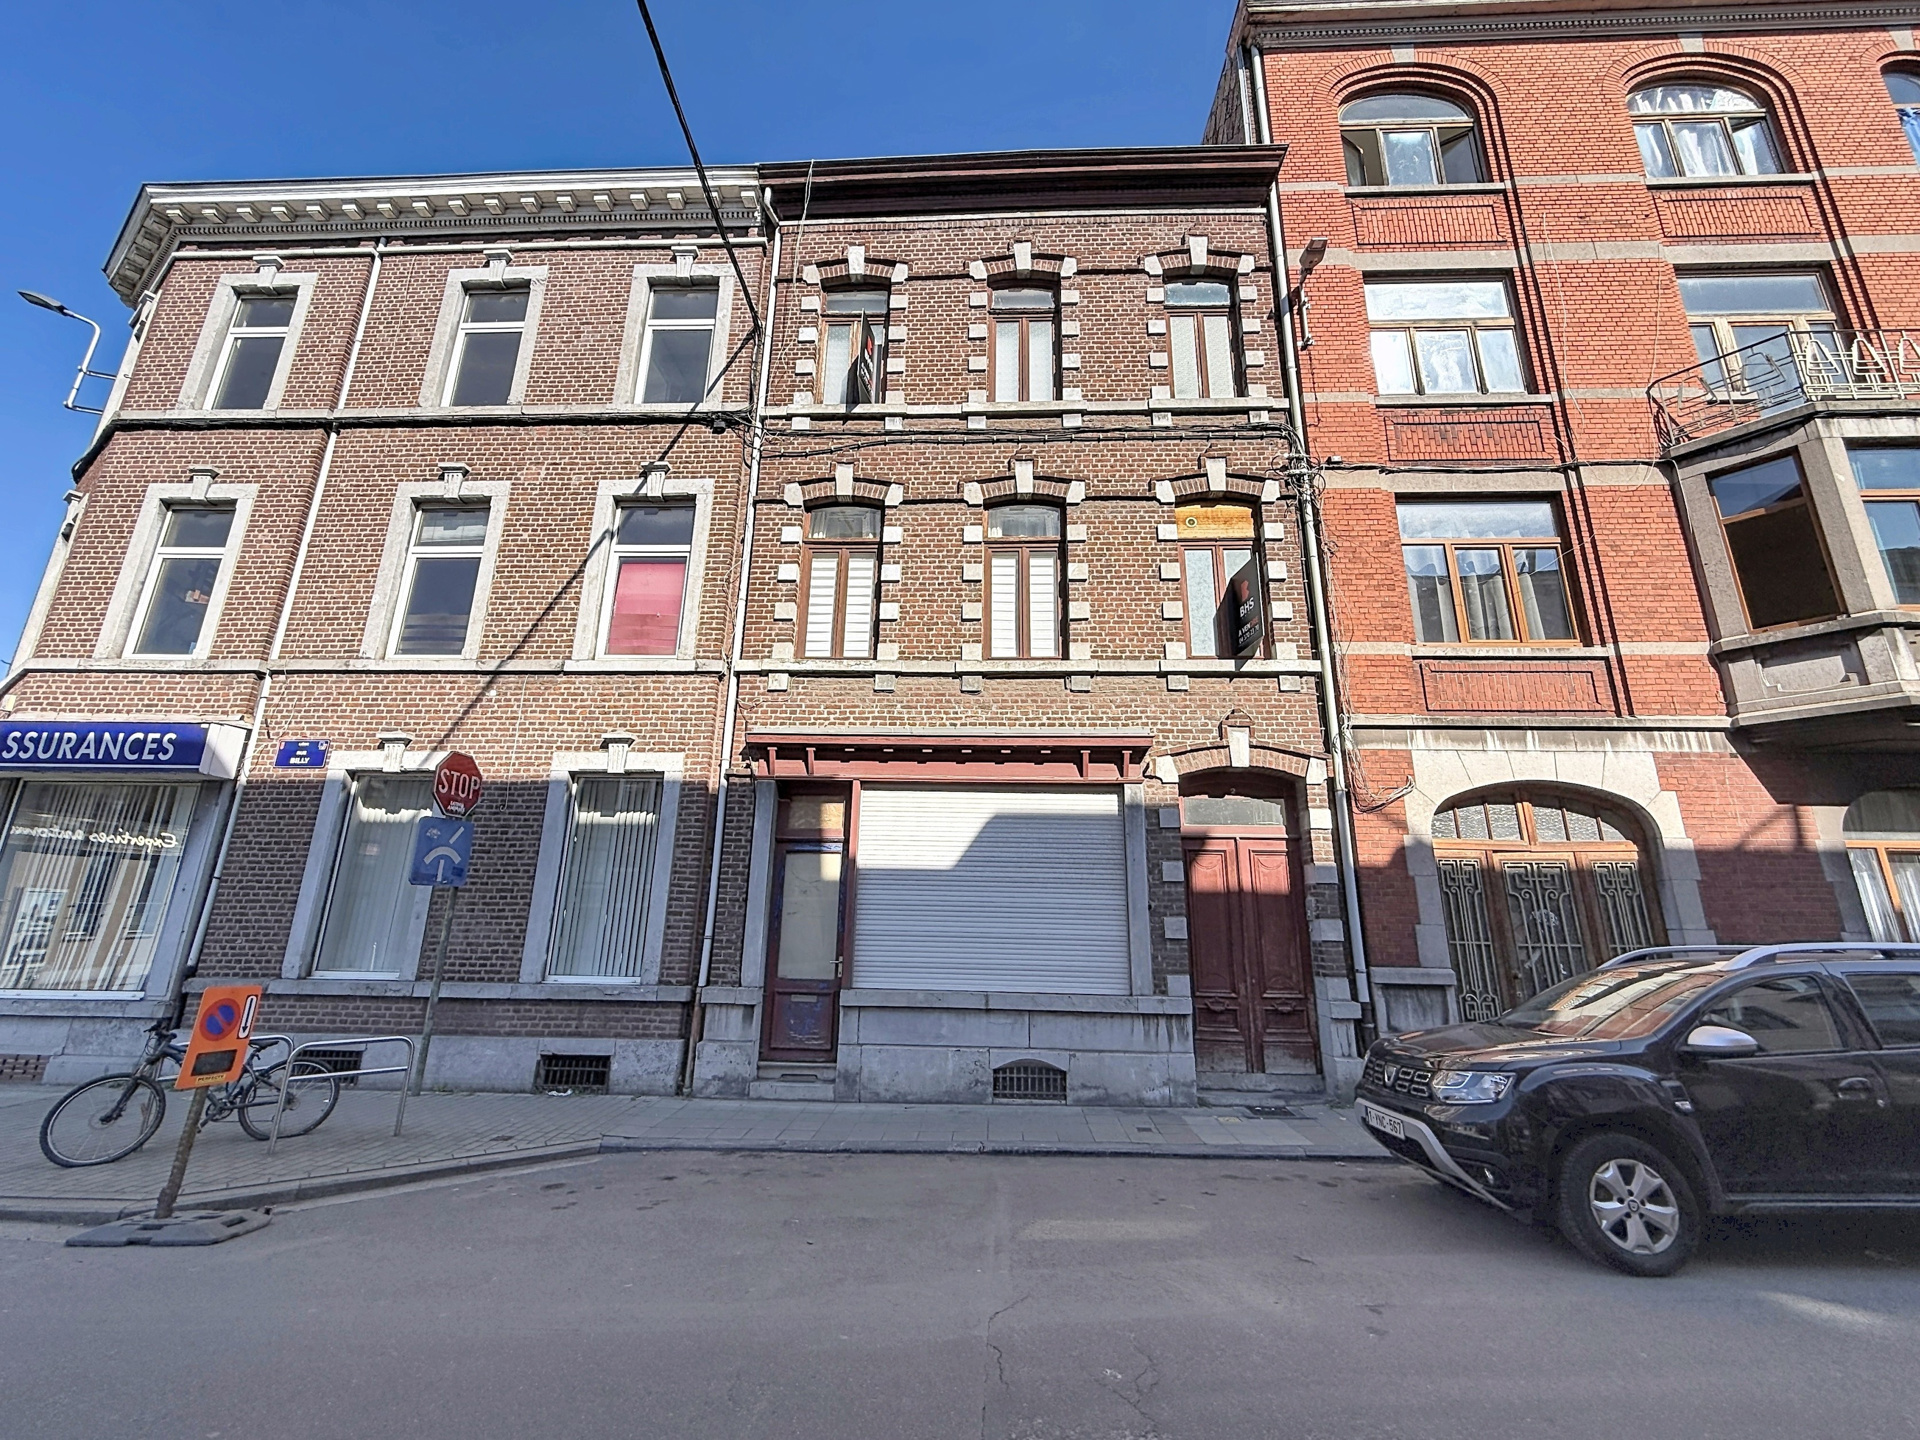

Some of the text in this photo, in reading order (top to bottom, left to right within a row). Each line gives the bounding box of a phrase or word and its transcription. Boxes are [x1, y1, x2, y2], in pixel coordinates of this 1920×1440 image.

[1240, 597, 1254, 617] BHS
[2, 731, 178, 761] SSURANCES
[438, 768, 481, 800] STOP
[1368, 1110, 1402, 1135] 1-YNC-567
